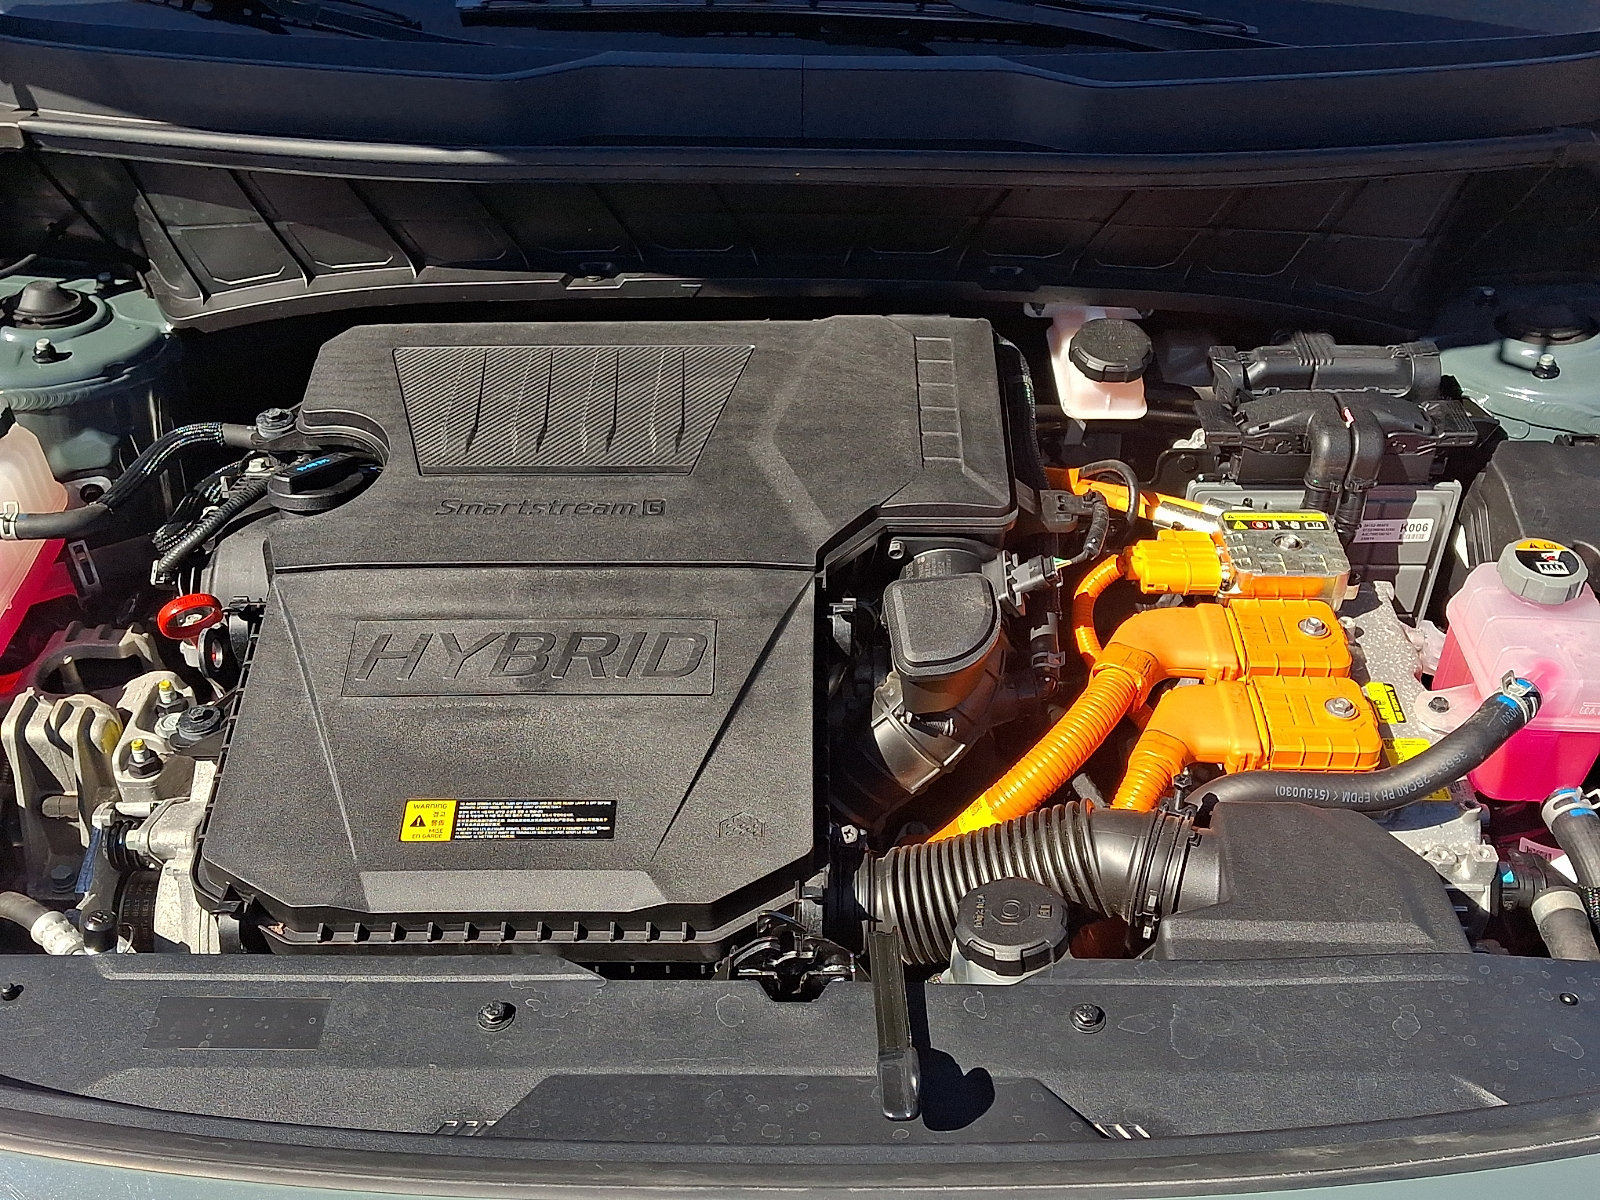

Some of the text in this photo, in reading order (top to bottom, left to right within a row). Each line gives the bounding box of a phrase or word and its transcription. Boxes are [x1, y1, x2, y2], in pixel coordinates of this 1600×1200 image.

[435, 498, 640, 516] Smartstream
[1400, 523, 1429, 533] K006
[354, 631, 709, 680] HYBRID
[1275, 784, 1330, 802] (513U030)
[1342, 791, 1371, 803] EPDM
